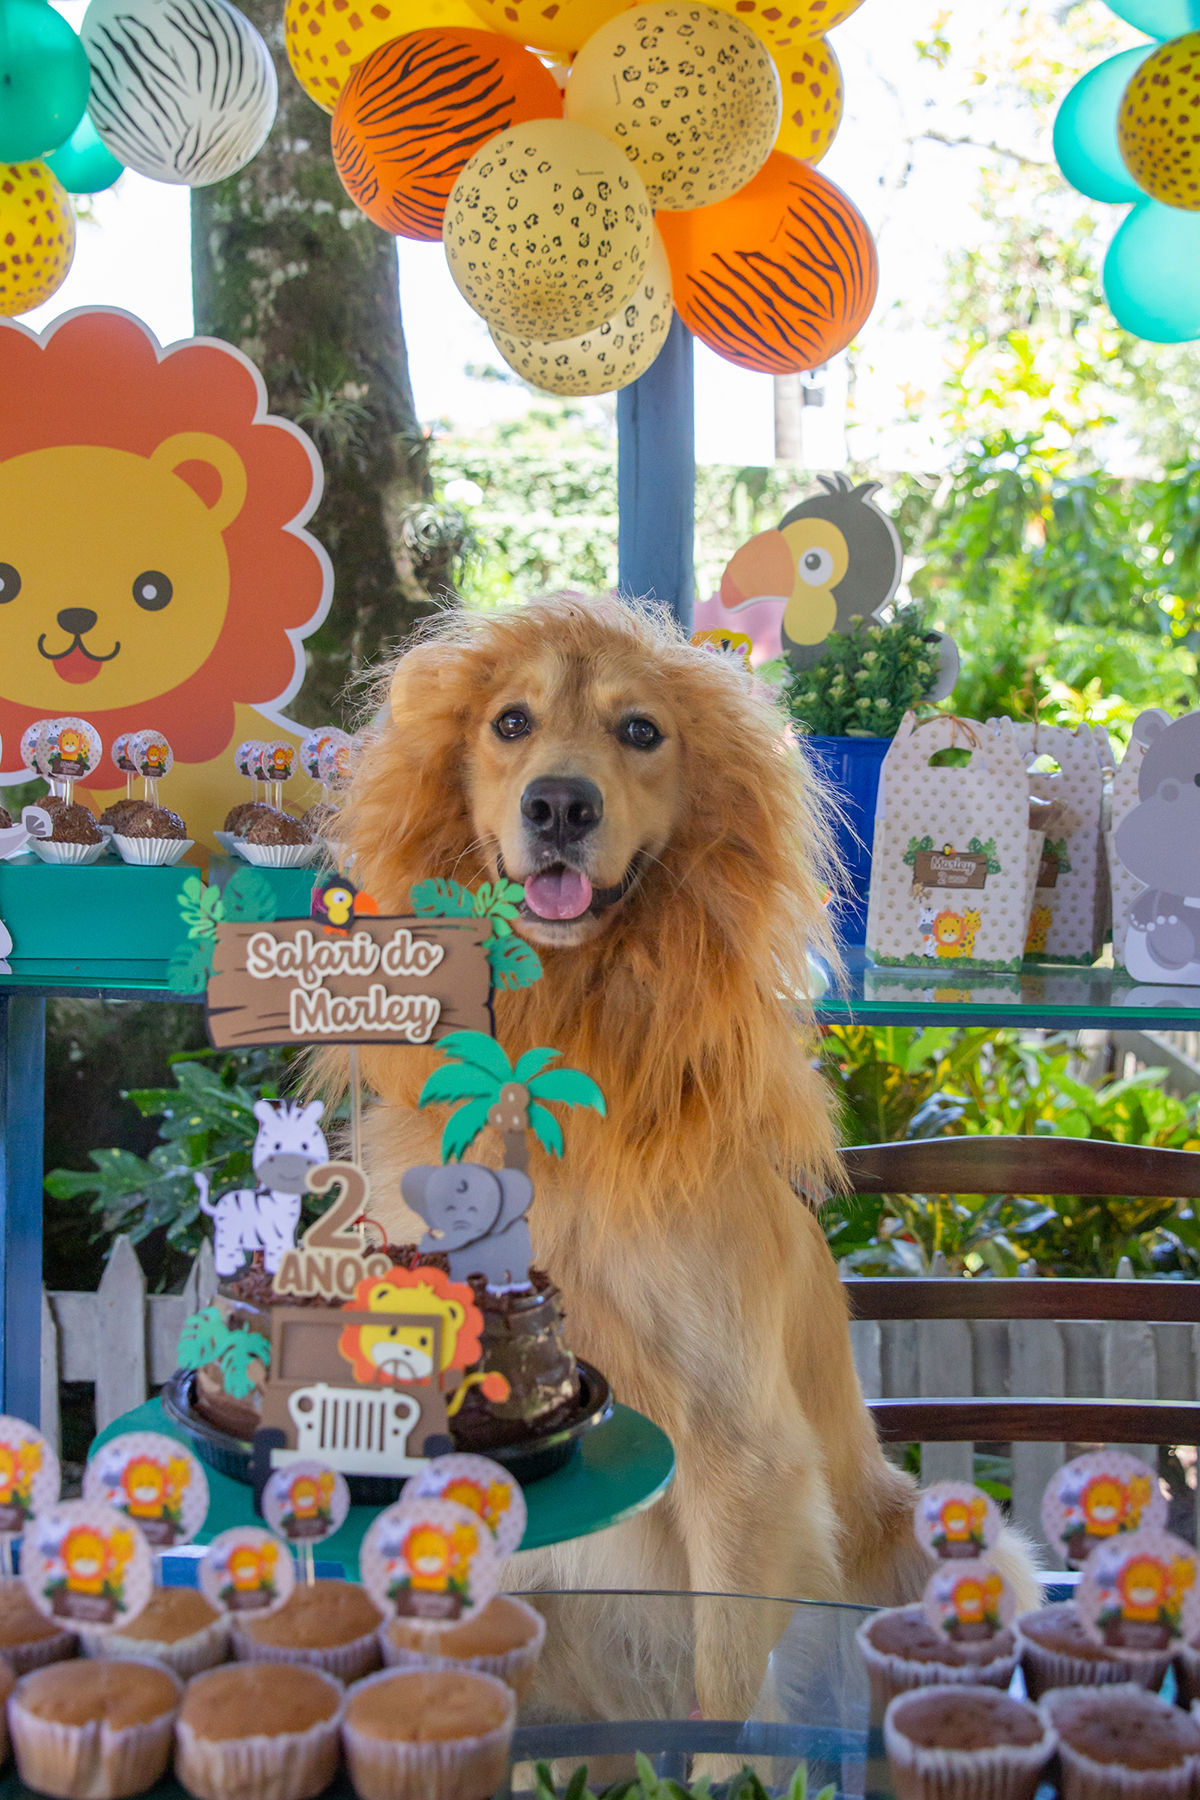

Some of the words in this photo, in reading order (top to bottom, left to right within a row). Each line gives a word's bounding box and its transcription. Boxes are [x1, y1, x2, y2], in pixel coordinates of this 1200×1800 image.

[931, 856, 976, 876] Marley
[247, 930, 380, 989] Safari
[381, 930, 444, 976] do
[290, 985, 440, 1043] Marley
[303, 1161, 369, 1252] 2
